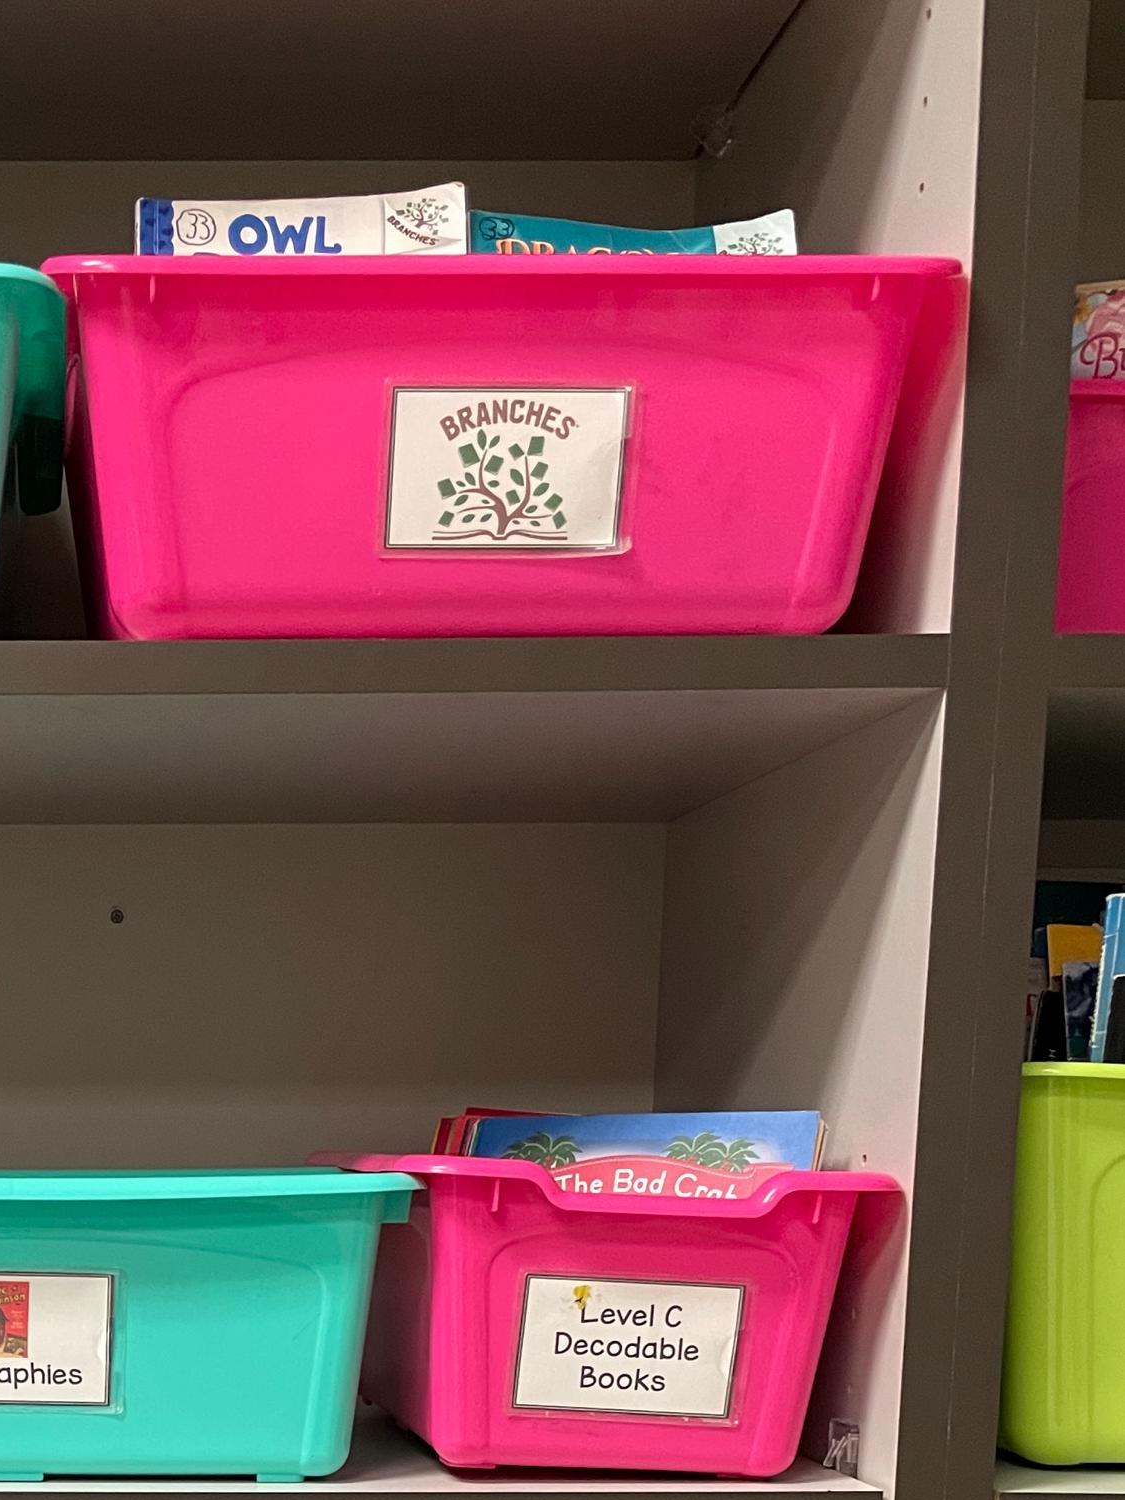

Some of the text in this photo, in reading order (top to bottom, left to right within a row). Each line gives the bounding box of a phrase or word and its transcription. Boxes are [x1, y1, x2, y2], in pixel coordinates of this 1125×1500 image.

[228, 213, 343, 255] OWL
[386, 214, 439, 248] BRANCHES
[439, 398, 576, 441] BRANCHES
[555, 1173, 604, 1193] The
[611, 1168, 668, 1194] Bad
[580, 1303, 683, 1328] Level C
[554, 1331, 700, 1362] Decodable
[579, 1365, 666, 1392] Books
